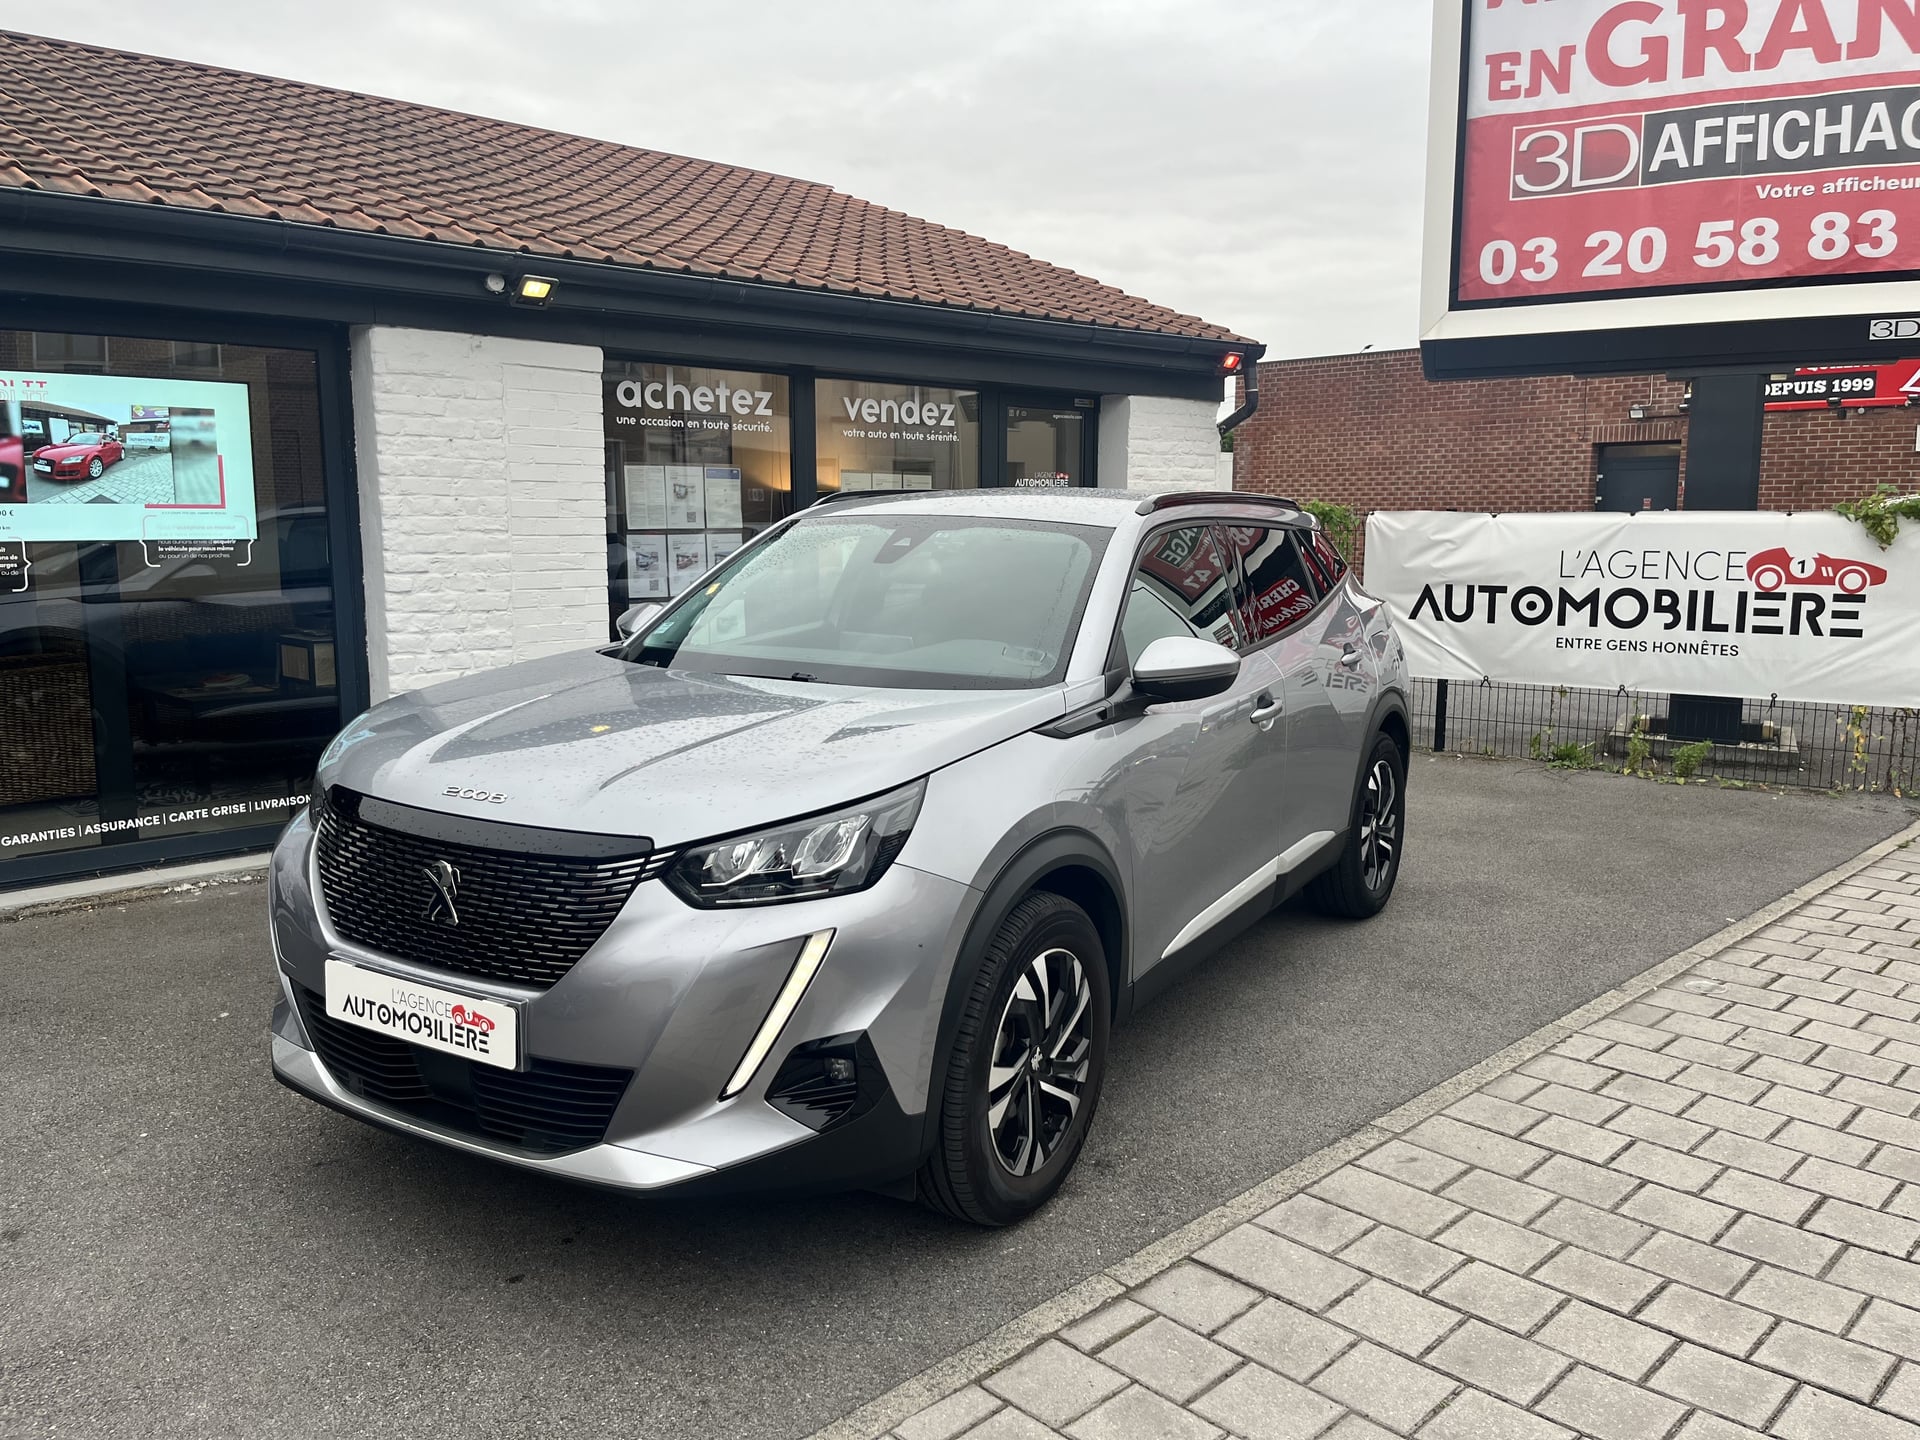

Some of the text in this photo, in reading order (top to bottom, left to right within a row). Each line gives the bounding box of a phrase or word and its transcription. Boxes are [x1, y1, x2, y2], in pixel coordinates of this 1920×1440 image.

[1485, 45, 1576, 101] EN
[1515, 123, 1639, 192] 3D
[1755, 184, 1815, 199] Votre
[1479, 209, 1898, 285] 03 20 58 83
[1871, 319, 1920, 339] 3D
[616, 367, 773, 416] achetez
[1832, 377, 1874, 393] 1999
[843, 386, 955, 427] vendez
[616, 415, 773, 433] une occasion en toute sécurité.
[843, 429, 866, 438] votre
[867, 429, 888, 439] auto
[903, 431, 924, 440] toute
[926, 430, 960, 442] sérénité.
[1556, 637, 1740, 656] ENTRE GENS HONNÊTES
[1, 827, 76, 847] GARANTIES
[84, 815, 161, 835] ASSURANCE
[169, 809, 209, 823] CARTE
[211, 803, 247, 817] GRISE
